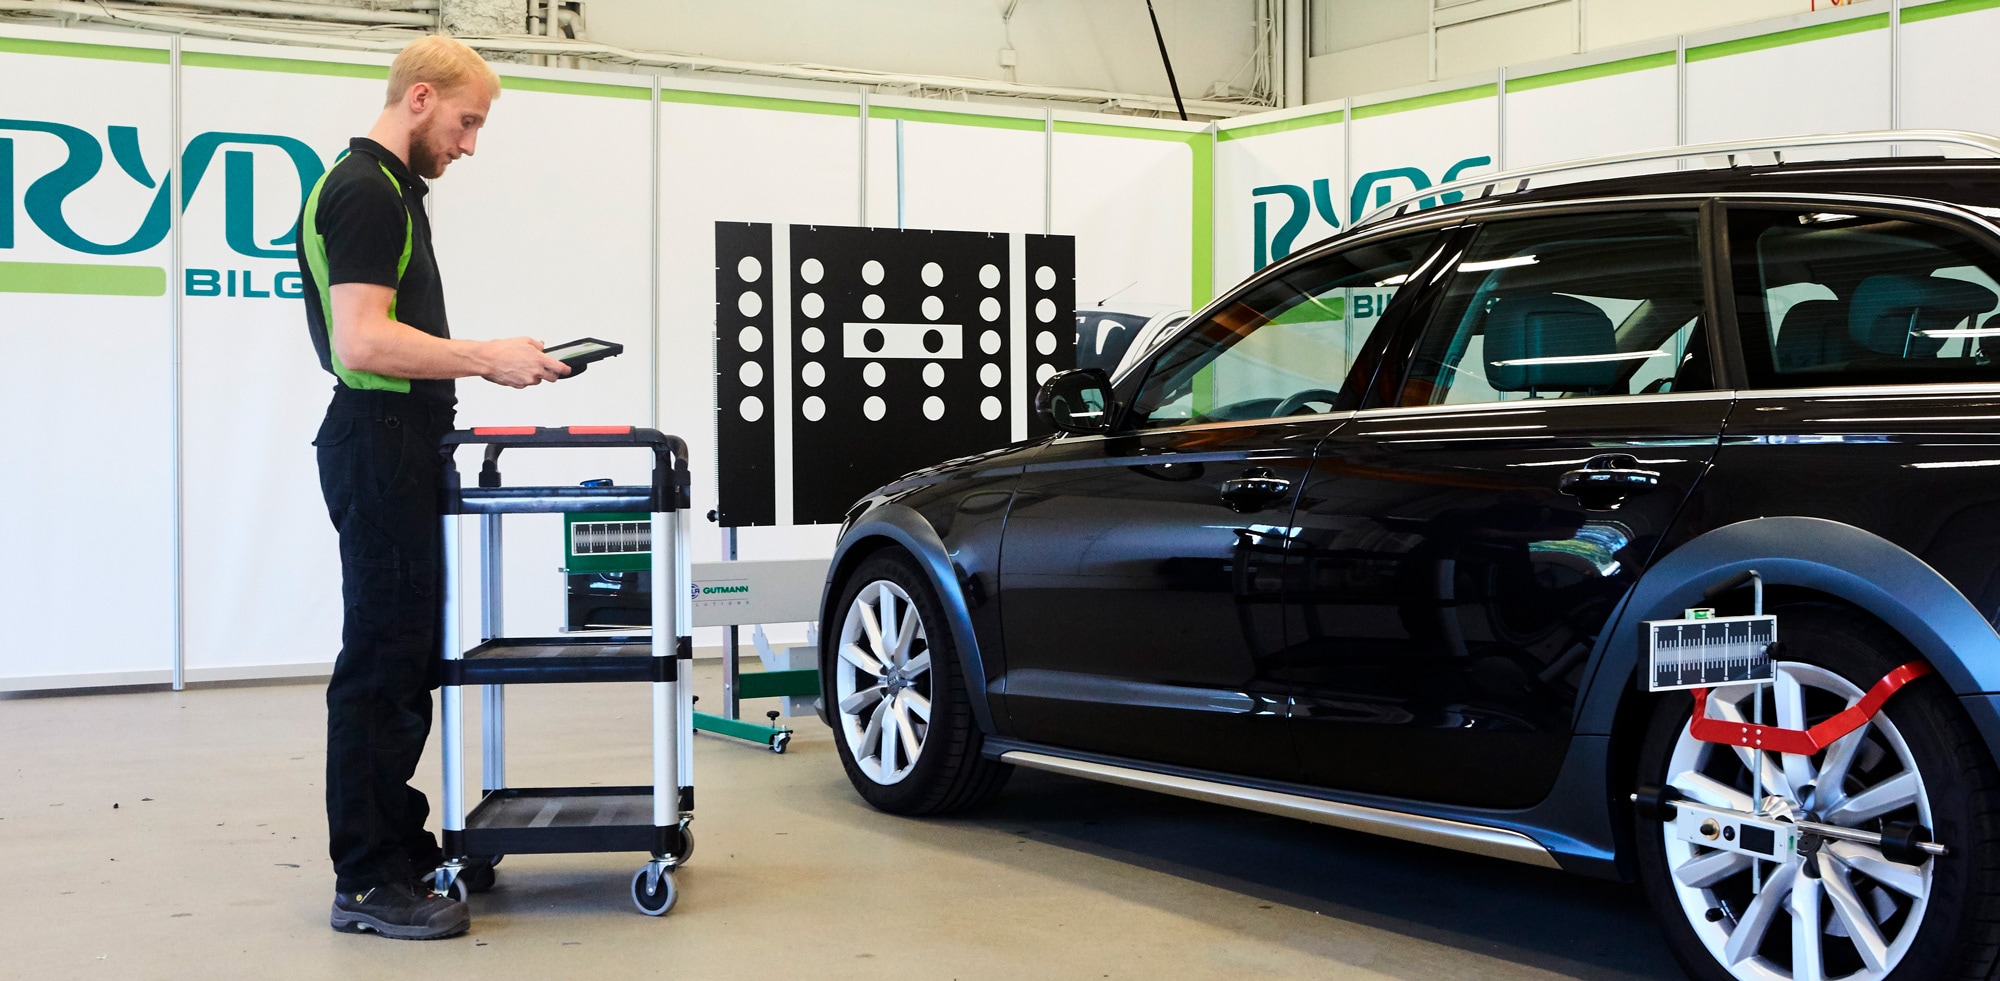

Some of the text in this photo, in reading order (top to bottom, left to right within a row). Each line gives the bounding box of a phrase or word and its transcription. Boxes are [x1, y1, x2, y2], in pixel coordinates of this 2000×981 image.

[0, 119, 350, 259] RYD
[185, 268, 303, 299] BILG
[703, 586, 749, 594] GUTMANN
